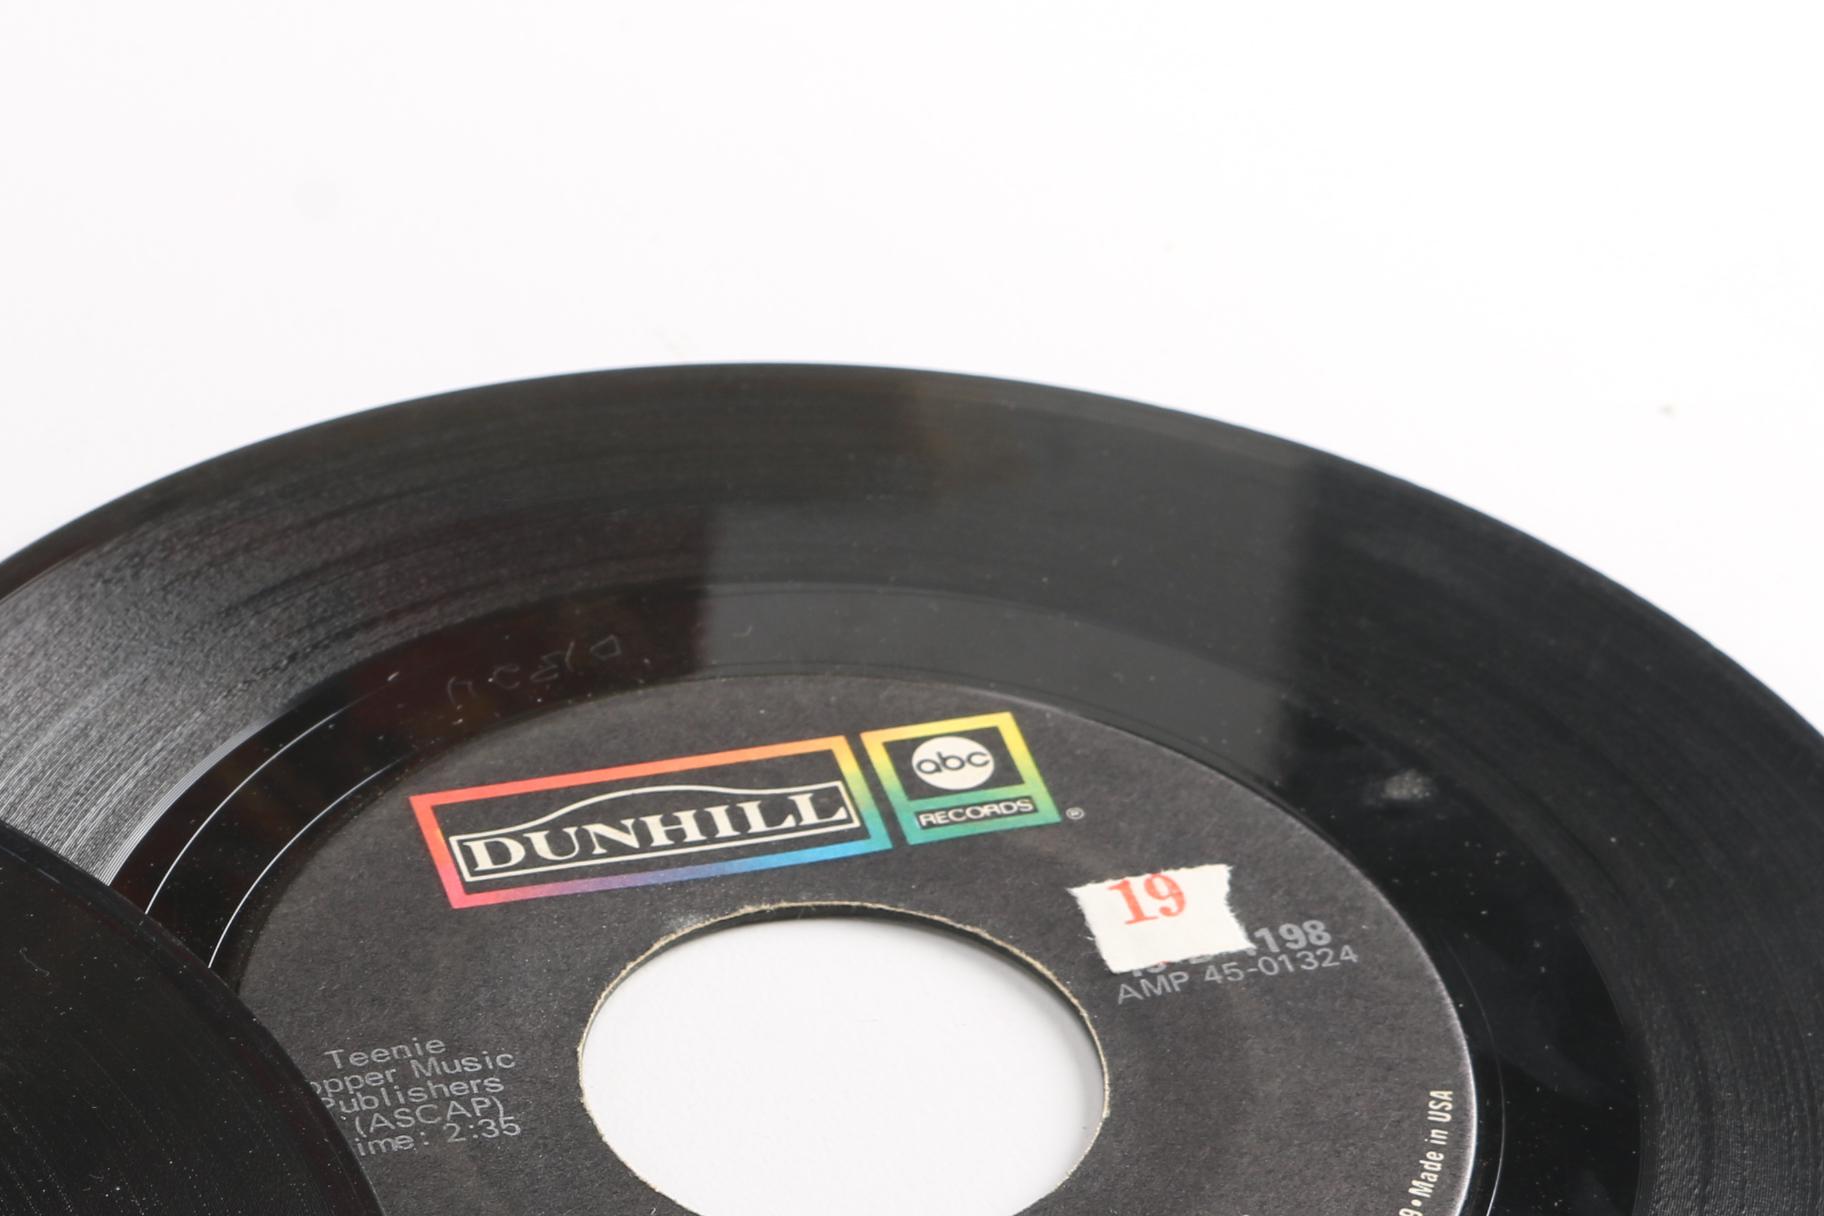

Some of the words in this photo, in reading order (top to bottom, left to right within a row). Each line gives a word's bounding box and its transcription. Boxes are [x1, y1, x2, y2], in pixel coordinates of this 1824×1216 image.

[915, 751, 991, 775] abc
[918, 799, 1035, 828] RECORDS
[473, 792, 851, 873] DUNHILL
[1107, 873, 1188, 926] 19
[1117, 971, 1190, 1004] AMP
[1203, 944, 1359, 985] 45-01324
[323, 1037, 447, 1070] Teenie
[409, 1051, 517, 1080] Music
[355, 1096, 507, 1139] (ASCAP)
[1426, 1089, 1455, 1123] USA
[354, 1131, 430, 1156] ime:
[441, 1115, 522, 1144] 2:35
[1424, 1128, 1450, 1146] in
